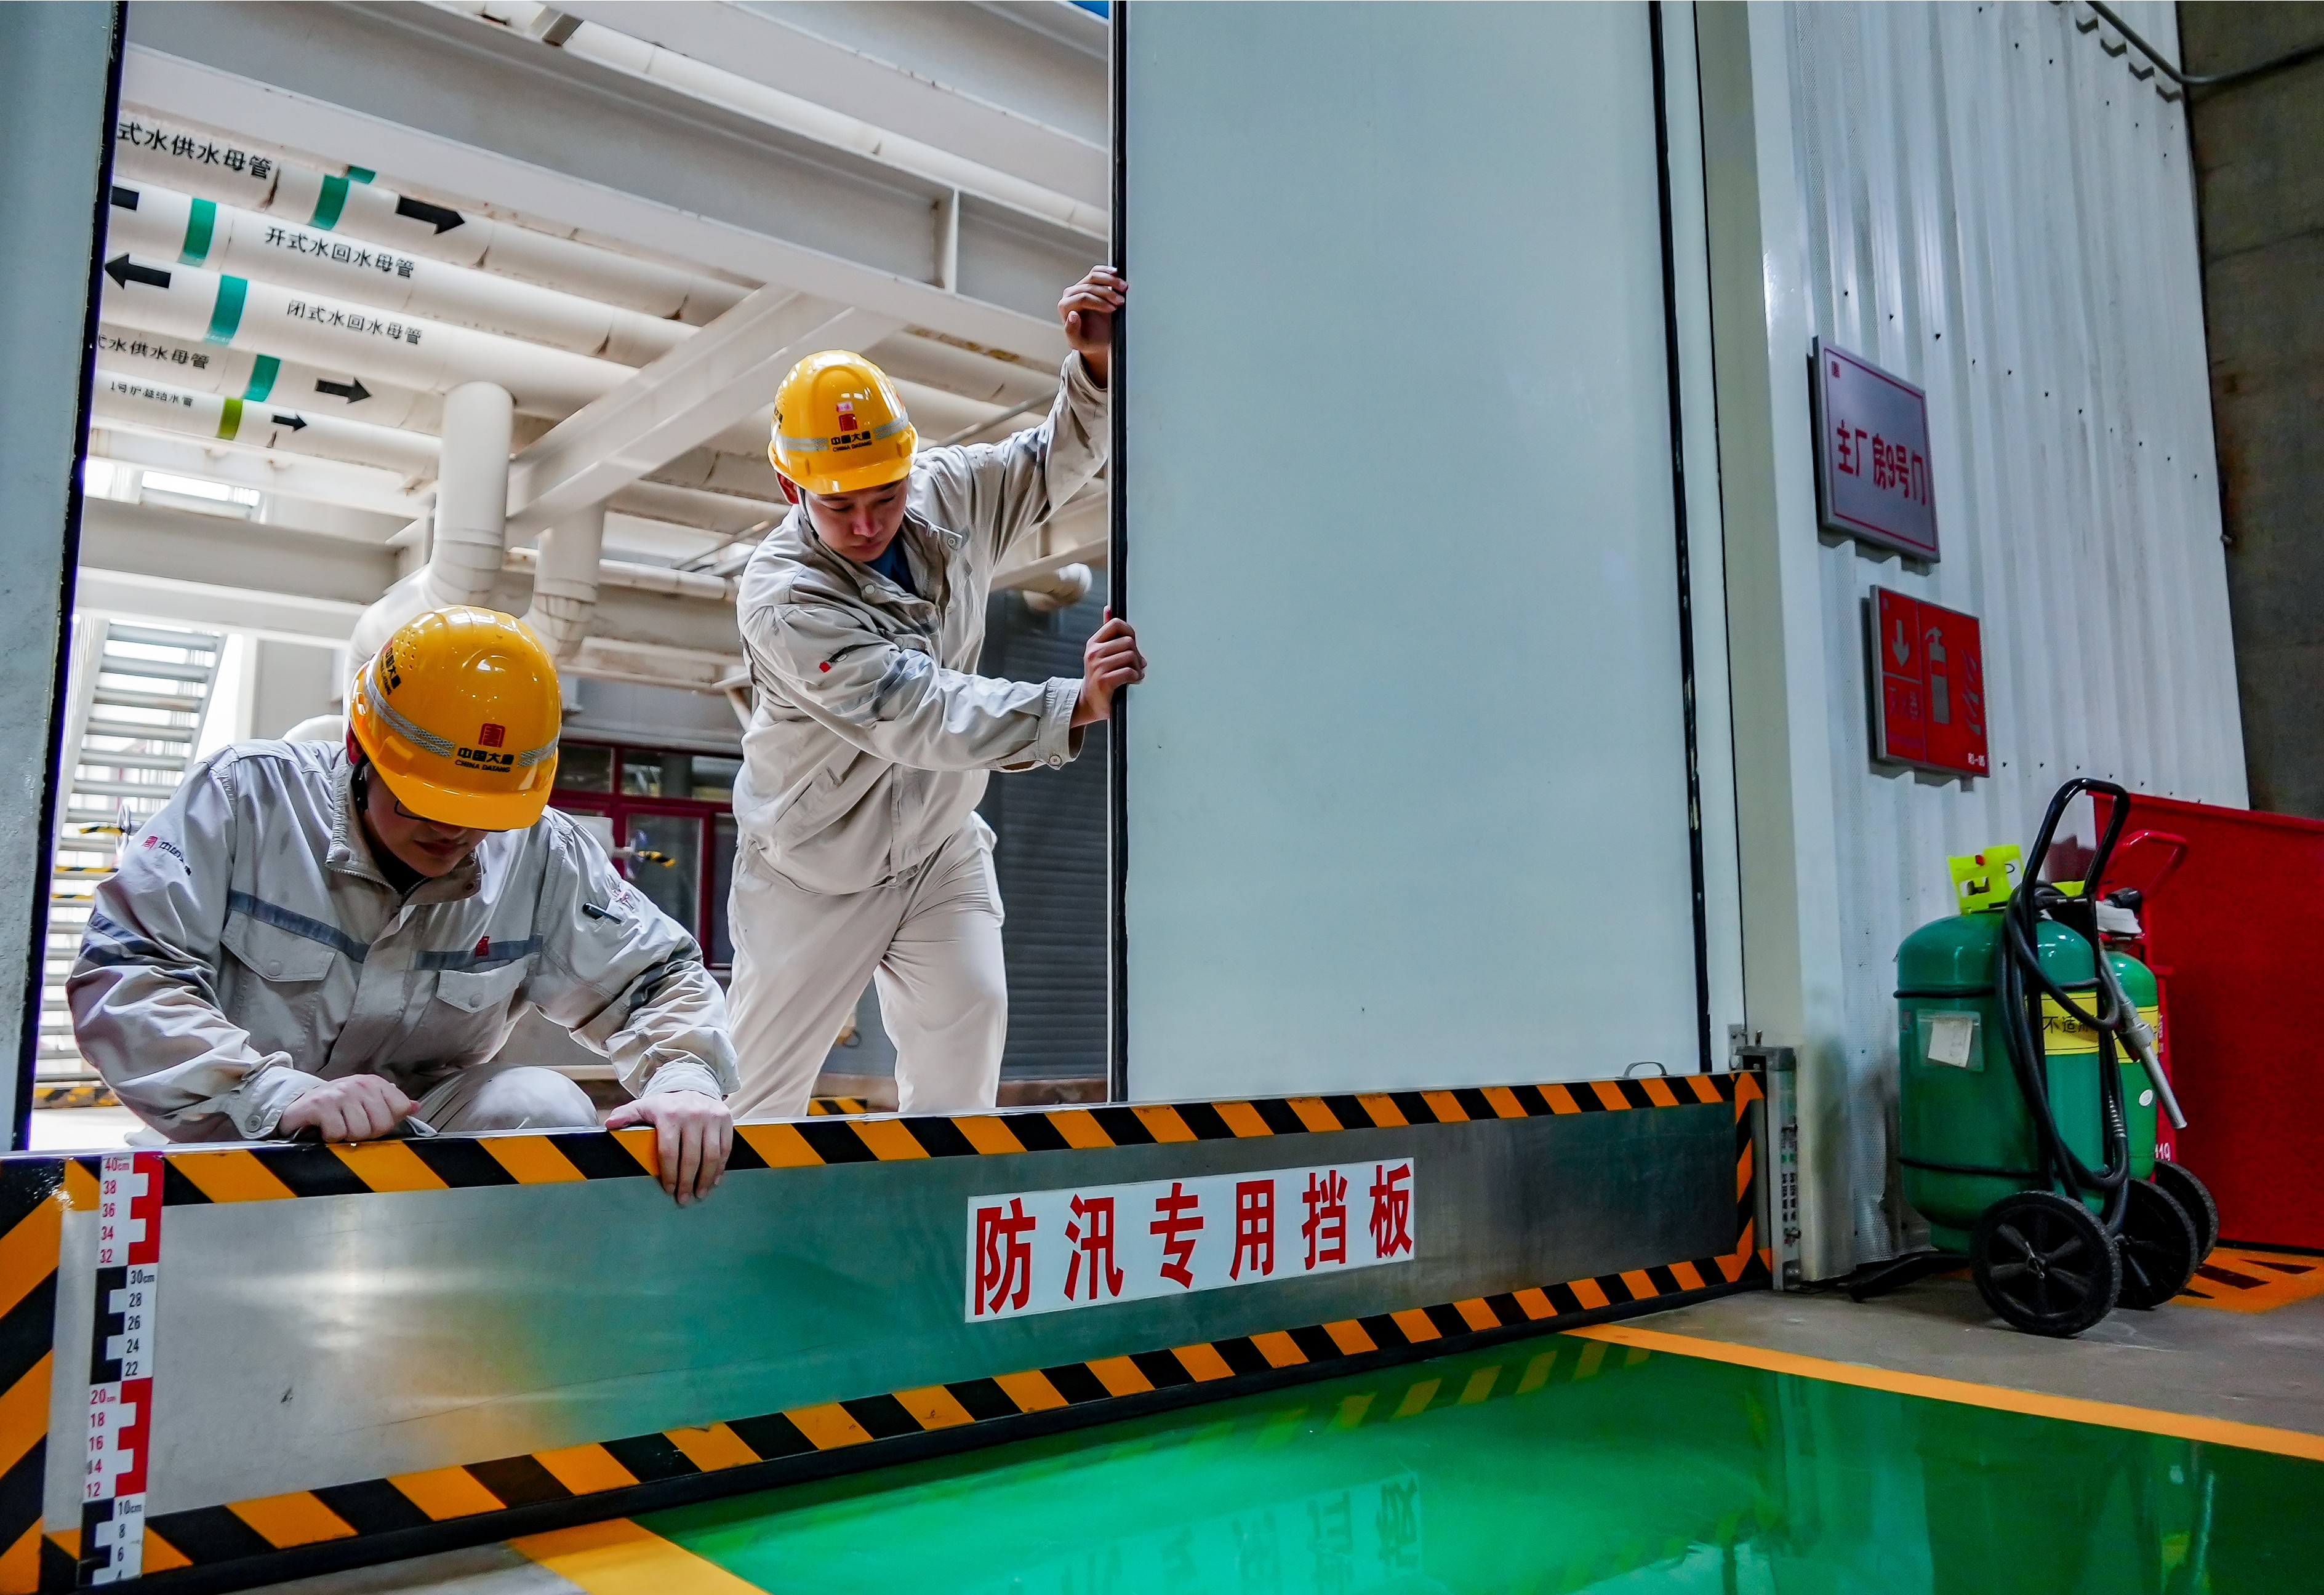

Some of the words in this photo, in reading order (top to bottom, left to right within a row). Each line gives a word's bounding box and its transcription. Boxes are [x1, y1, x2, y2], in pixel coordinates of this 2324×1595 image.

[265, 226, 415, 279] 开式水回水母管
[287, 298, 423, 345] 闭式水回水母管
[1837, 419, 1926, 505] 主厂房9号门
[455, 759, 479, 769] CHINA
[457, 748, 515, 765] 中国大唐
[105, 1157, 129, 1171] 40cm
[103, 1181, 116, 1194] 38
[102, 1203, 115, 1217] 36
[101, 1226, 114, 1240] 34
[974, 1163, 1412, 1316] 防汛专用挡板
[100, 1249, 113, 1263] 32
[130, 1269, 154, 1284] 30cm
[129, 1292, 142, 1307] 28
[127, 1315, 140, 1330] 26
[126, 1338, 139, 1354] 24
[125, 1361, 138, 1377] 22
[90, 1388, 116, 1405] 20cm
[90, 1412, 105, 1427] 18
[89, 1436, 103, 1451] 16
[87, 1458, 102, 1474] 14
[87, 1481, 100, 1498] 12
[118, 1500, 142, 1516] 10cm
[119, 1524, 126, 1539] 8
[118, 1546, 124, 1562] 6
